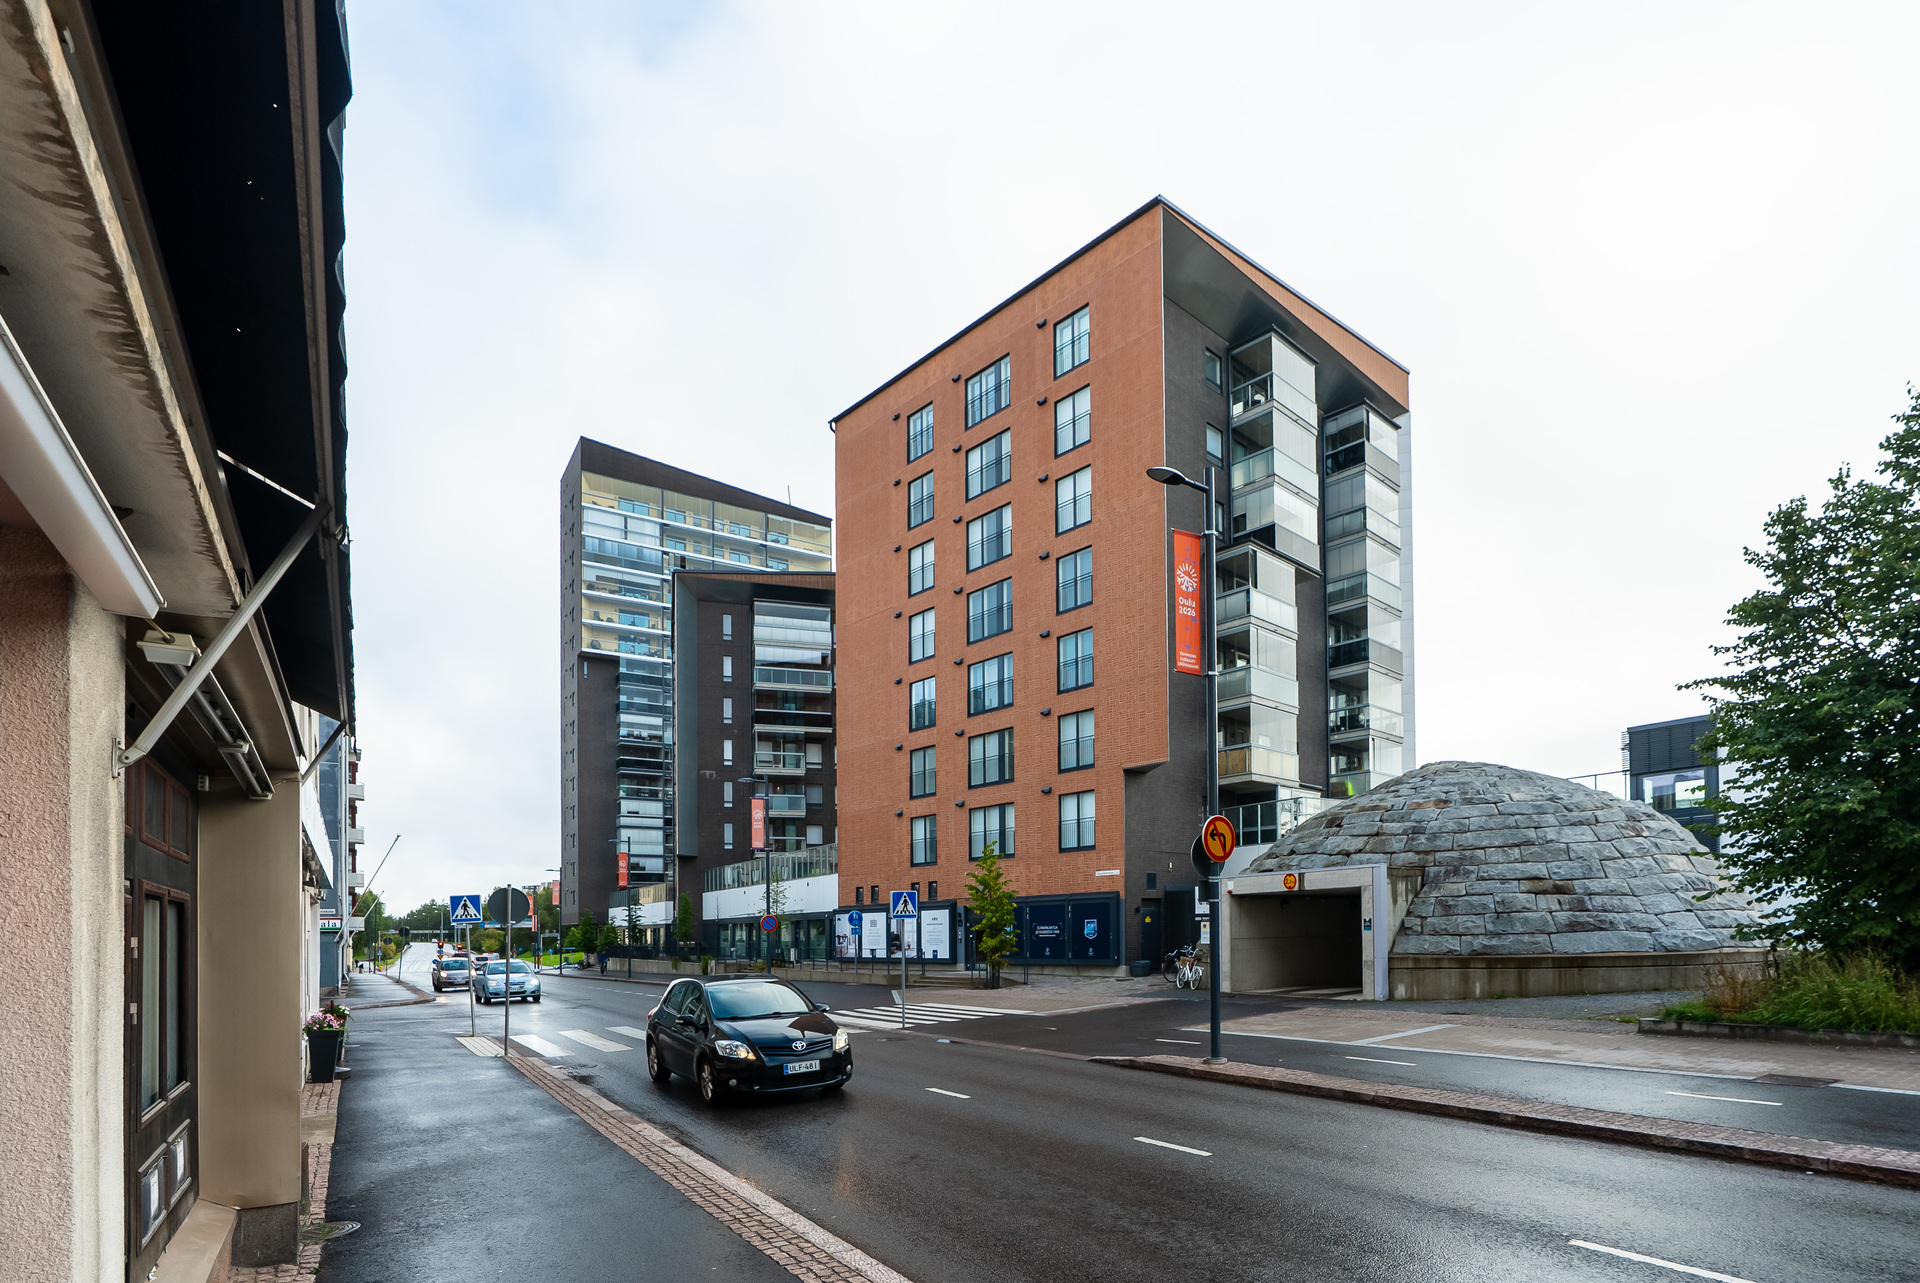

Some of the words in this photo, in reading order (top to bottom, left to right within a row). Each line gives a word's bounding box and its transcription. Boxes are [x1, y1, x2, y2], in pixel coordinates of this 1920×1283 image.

[1178, 596, 1196, 608] Oulu
[1178, 605, 1196, 617] 2026
[789, 1062, 817, 1073] ULF-481
